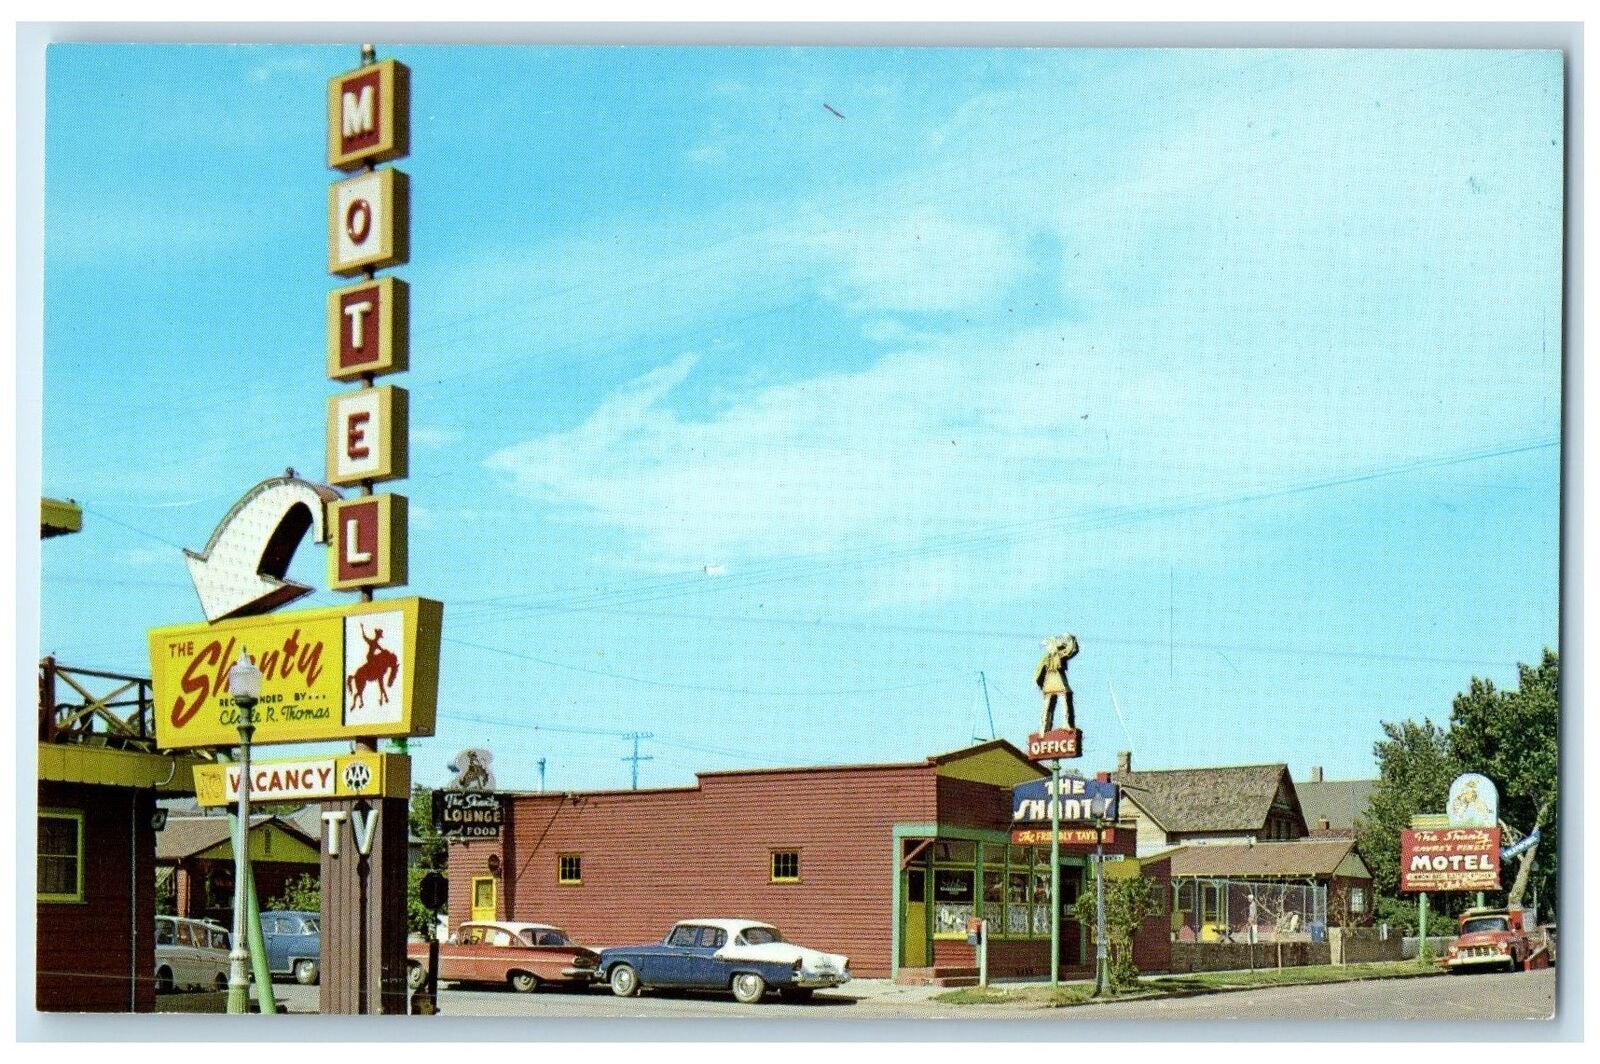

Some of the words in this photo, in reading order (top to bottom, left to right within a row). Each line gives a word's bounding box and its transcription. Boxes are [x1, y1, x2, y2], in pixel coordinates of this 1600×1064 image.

[342, 85, 374, 563] MOTEL
[169, 641, 194, 657] THE
[171, 629, 323, 728] Shnty
[219, 694, 284, 706] RECNDED
[220, 709, 261, 725] Cle
[266, 706, 278, 722] R.
[281, 704, 330, 721] Thomas
[1031, 739, 1076, 755] OFFICE
[229, 768, 332, 793] VCANCY
[1044, 778, 1086, 795] THE
[444, 793, 464, 809] The
[443, 808, 501, 823] LOUNGE
[321, 810, 379, 855] TV
[466, 826, 497, 836] FOOD
[1036, 830, 1073, 841] FRIDLY
[1076, 830, 1106, 841] TAVEN
[1414, 831, 1439, 841] The
[1410, 854, 1494, 871] MOTEL
